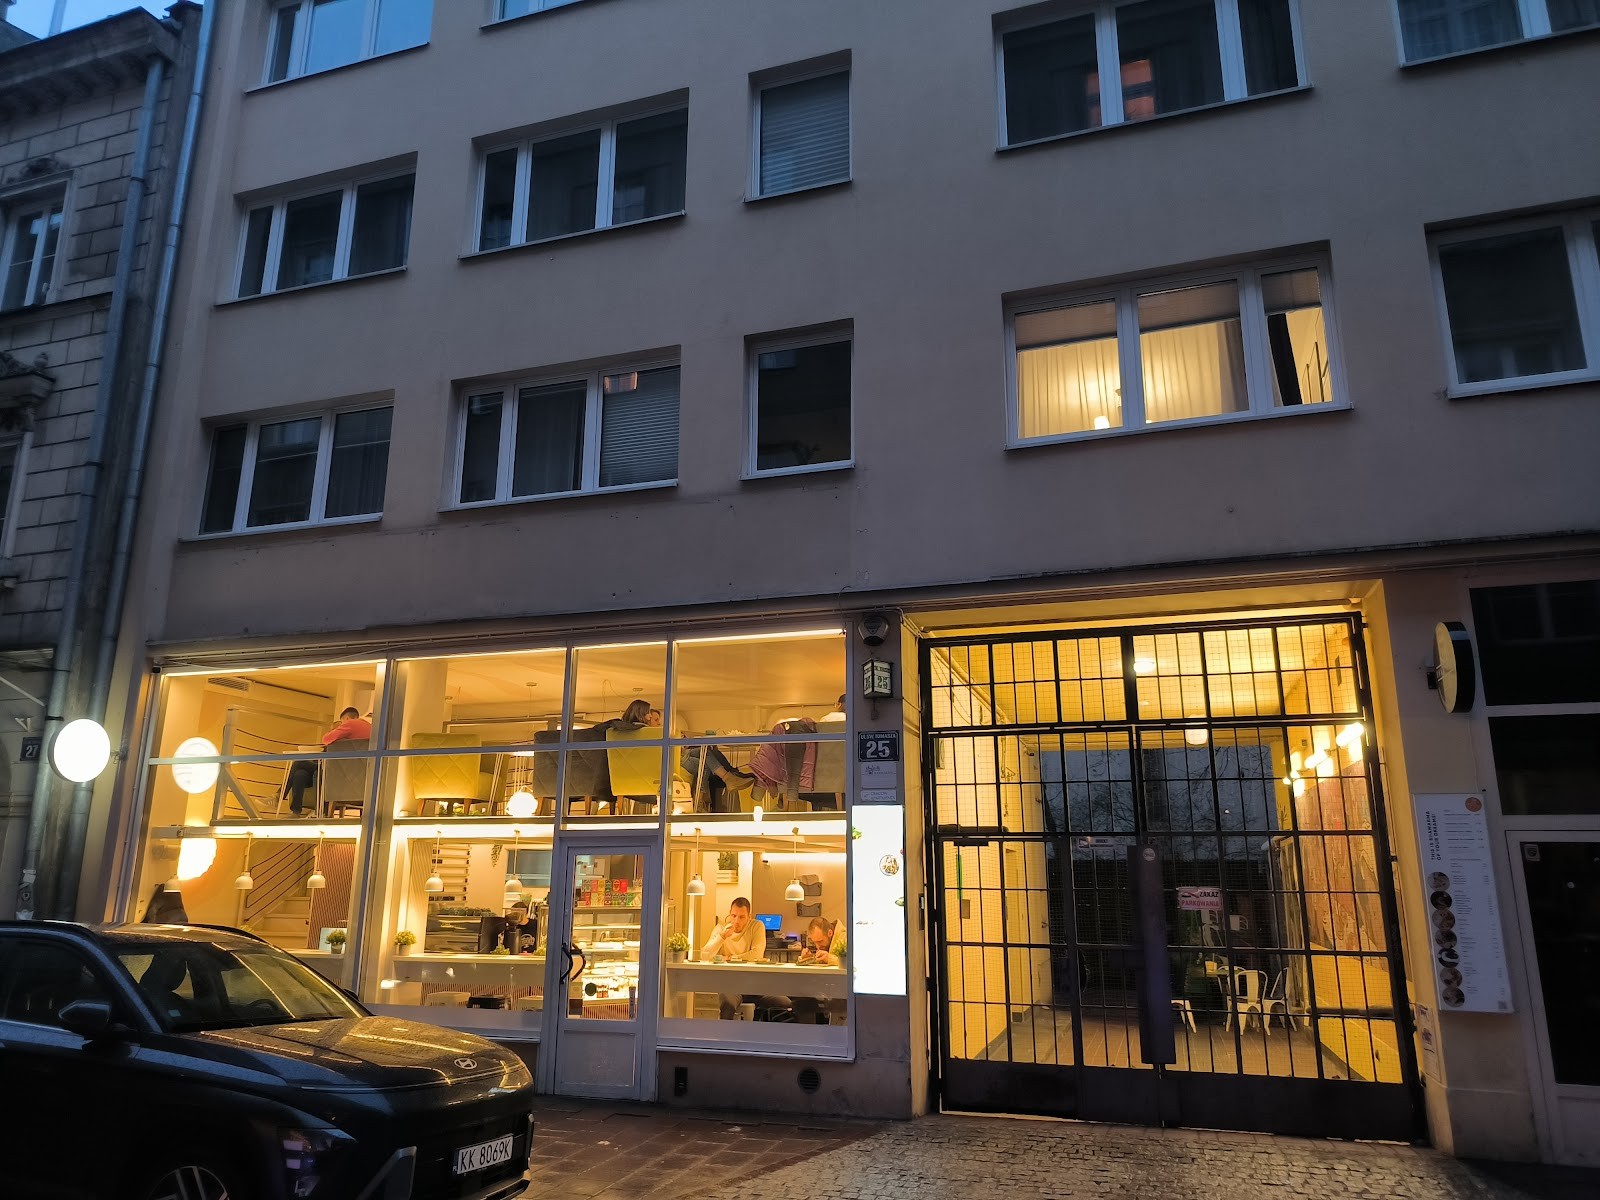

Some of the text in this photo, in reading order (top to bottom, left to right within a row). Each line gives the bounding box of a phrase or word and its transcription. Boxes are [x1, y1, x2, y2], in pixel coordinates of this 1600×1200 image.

[877, 675, 888, 689] 25
[25, 744, 39, 758] 27
[866, 740, 890, 758] 25
[1181, 899, 1219, 907] PARKOWANIA
[461, 1139, 511, 1171] KK 8069K
